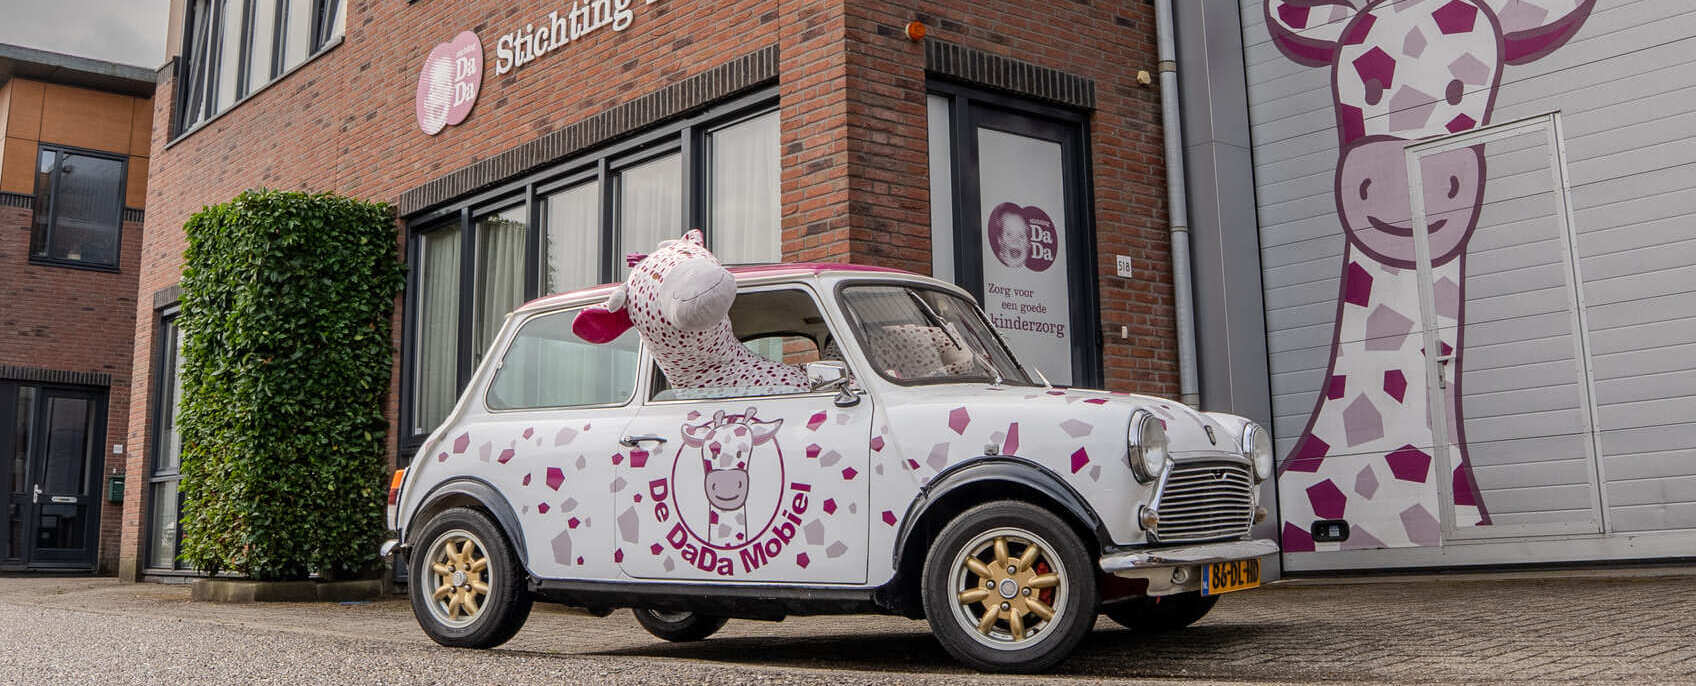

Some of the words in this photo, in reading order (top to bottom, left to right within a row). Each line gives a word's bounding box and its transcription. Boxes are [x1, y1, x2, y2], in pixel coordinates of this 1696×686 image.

[495, 0, 634, 75] Stichting
[455, 56, 477, 82] Da
[453, 81, 476, 107] Da
[1030, 224, 1053, 244] Da
[1031, 241, 1054, 261] Da
[1118, 260, 1131, 272] 518
[988, 282, 1011, 298] Zorg
[1014, 287, 1034, 298] voor
[1001, 301, 1018, 311] een
[1020, 302, 1048, 314] goede
[990, 313, 1065, 338] kinderzorg
[649, 478, 670, 523] De
[665, 522, 734, 576] DaDa
[739, 482, 811, 573] Mobiel
[1212, 559, 1259, 589] 86-DL-HD
